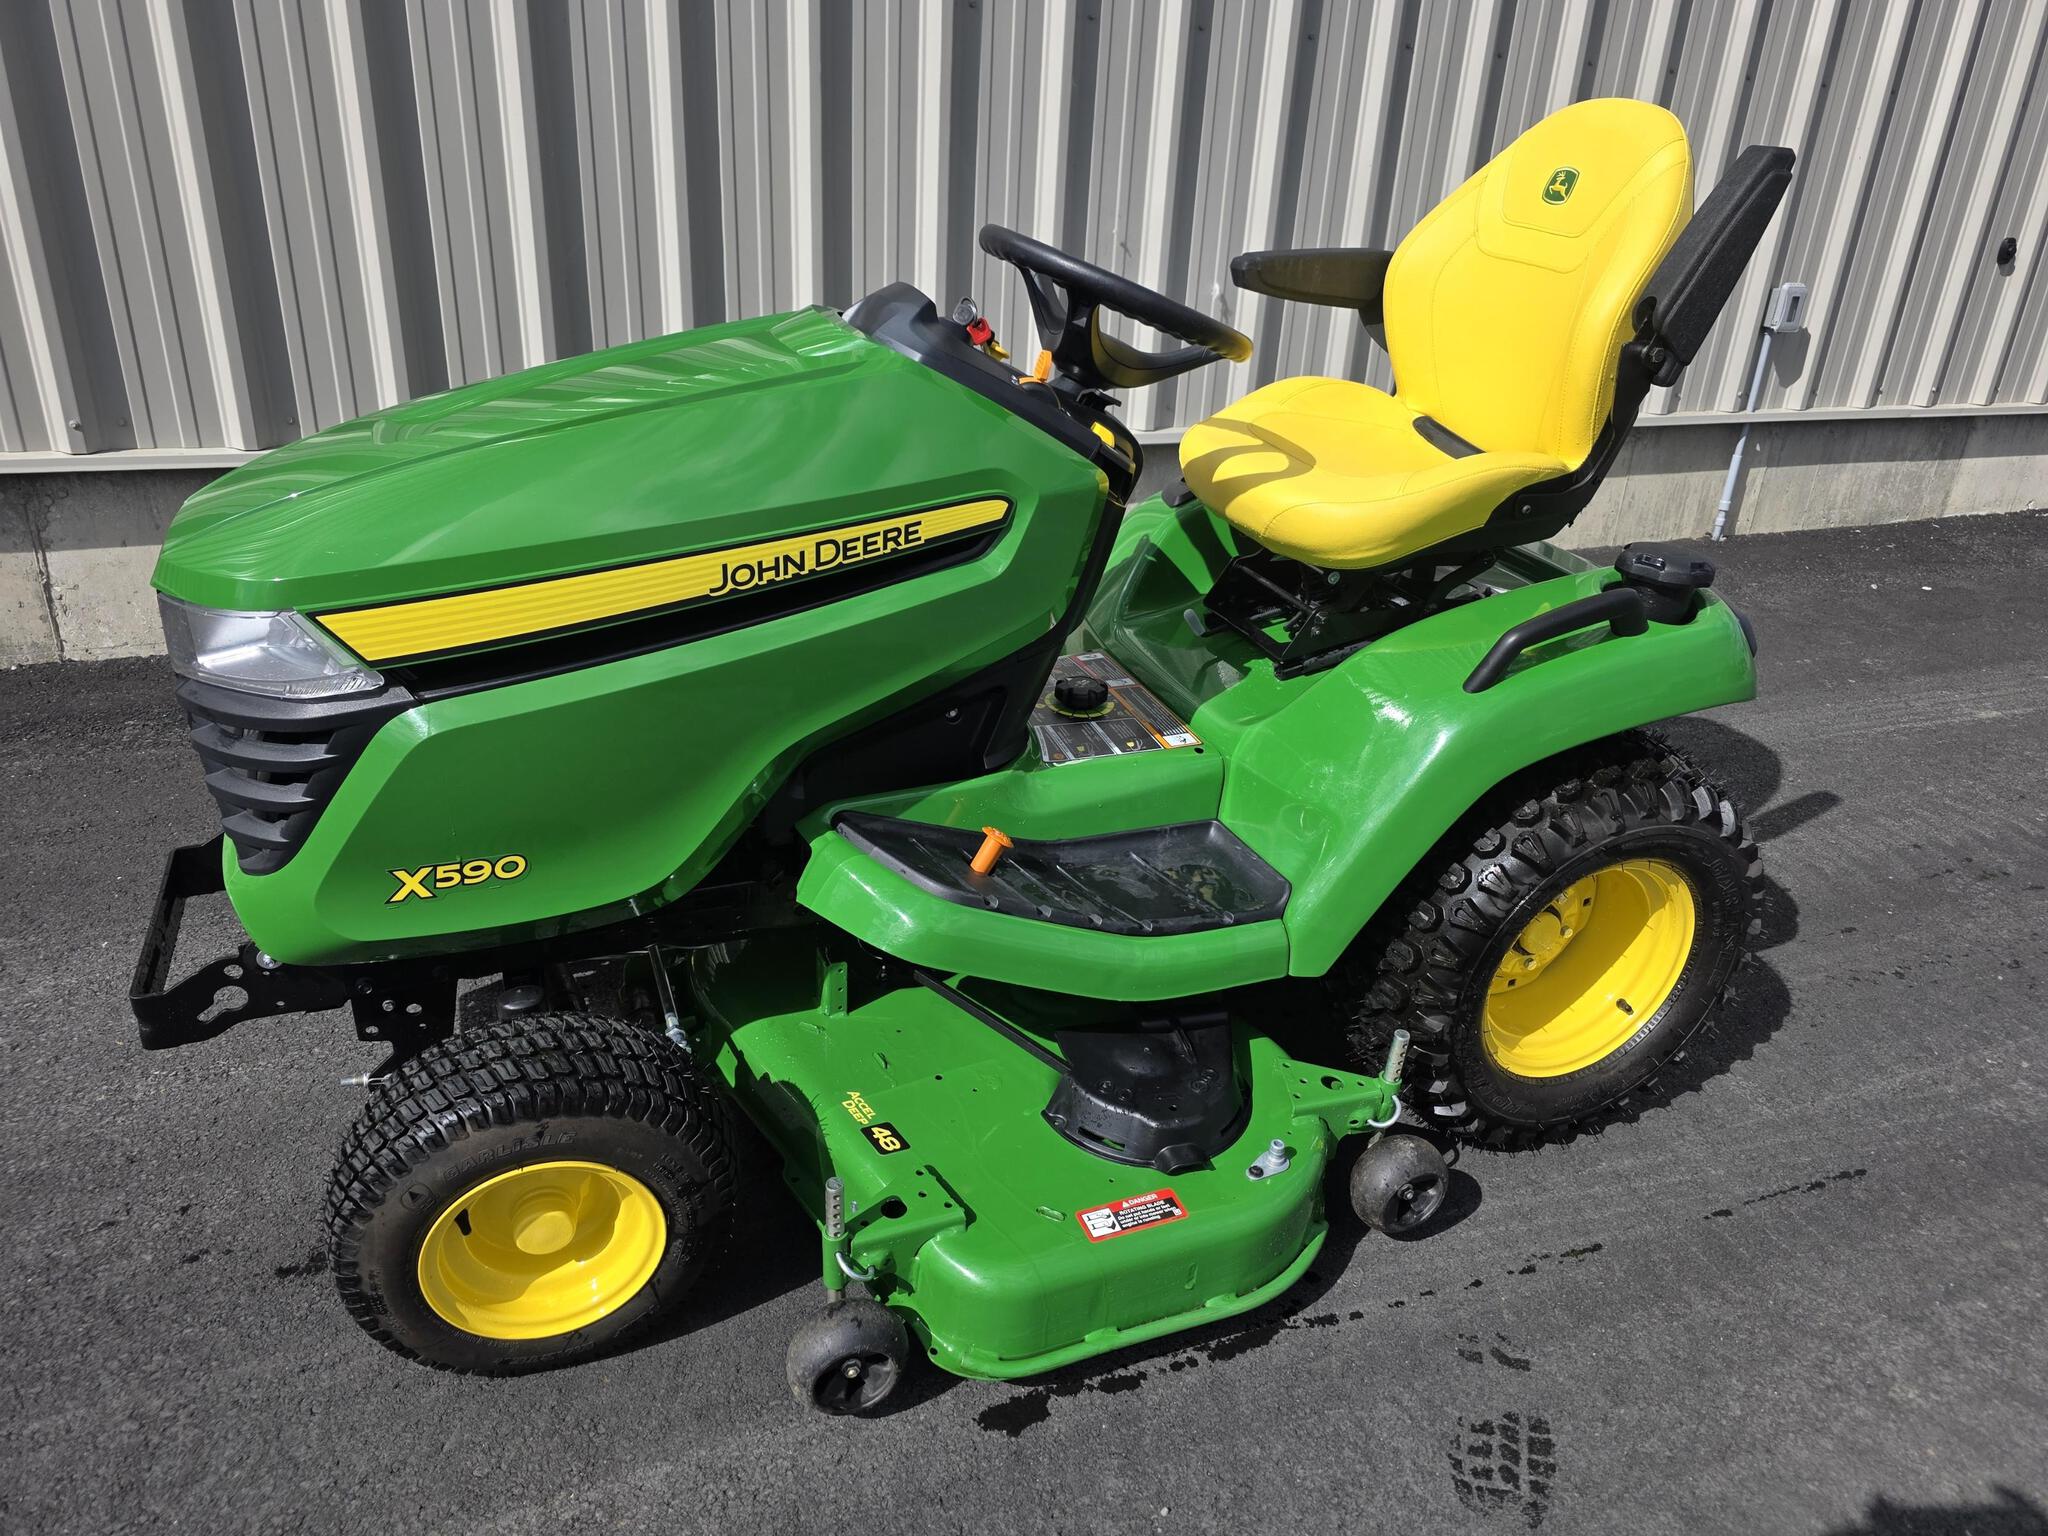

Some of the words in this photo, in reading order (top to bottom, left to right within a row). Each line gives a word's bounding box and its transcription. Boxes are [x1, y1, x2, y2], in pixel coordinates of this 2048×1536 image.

[708, 550, 806, 595] JOHN
[814, 520, 923, 570] DEERE
[386, 854, 528, 904] X590
[841, 1100, 869, 1125] DEEP
[846, 1091, 876, 1119] ACCEL
[871, 1126, 901, 1151] 48
[1119, 1204, 1147, 1215] ROTATING
[1146, 1200, 1165, 1209] BLADE
[1128, 1194, 1158, 1205] DANGER
